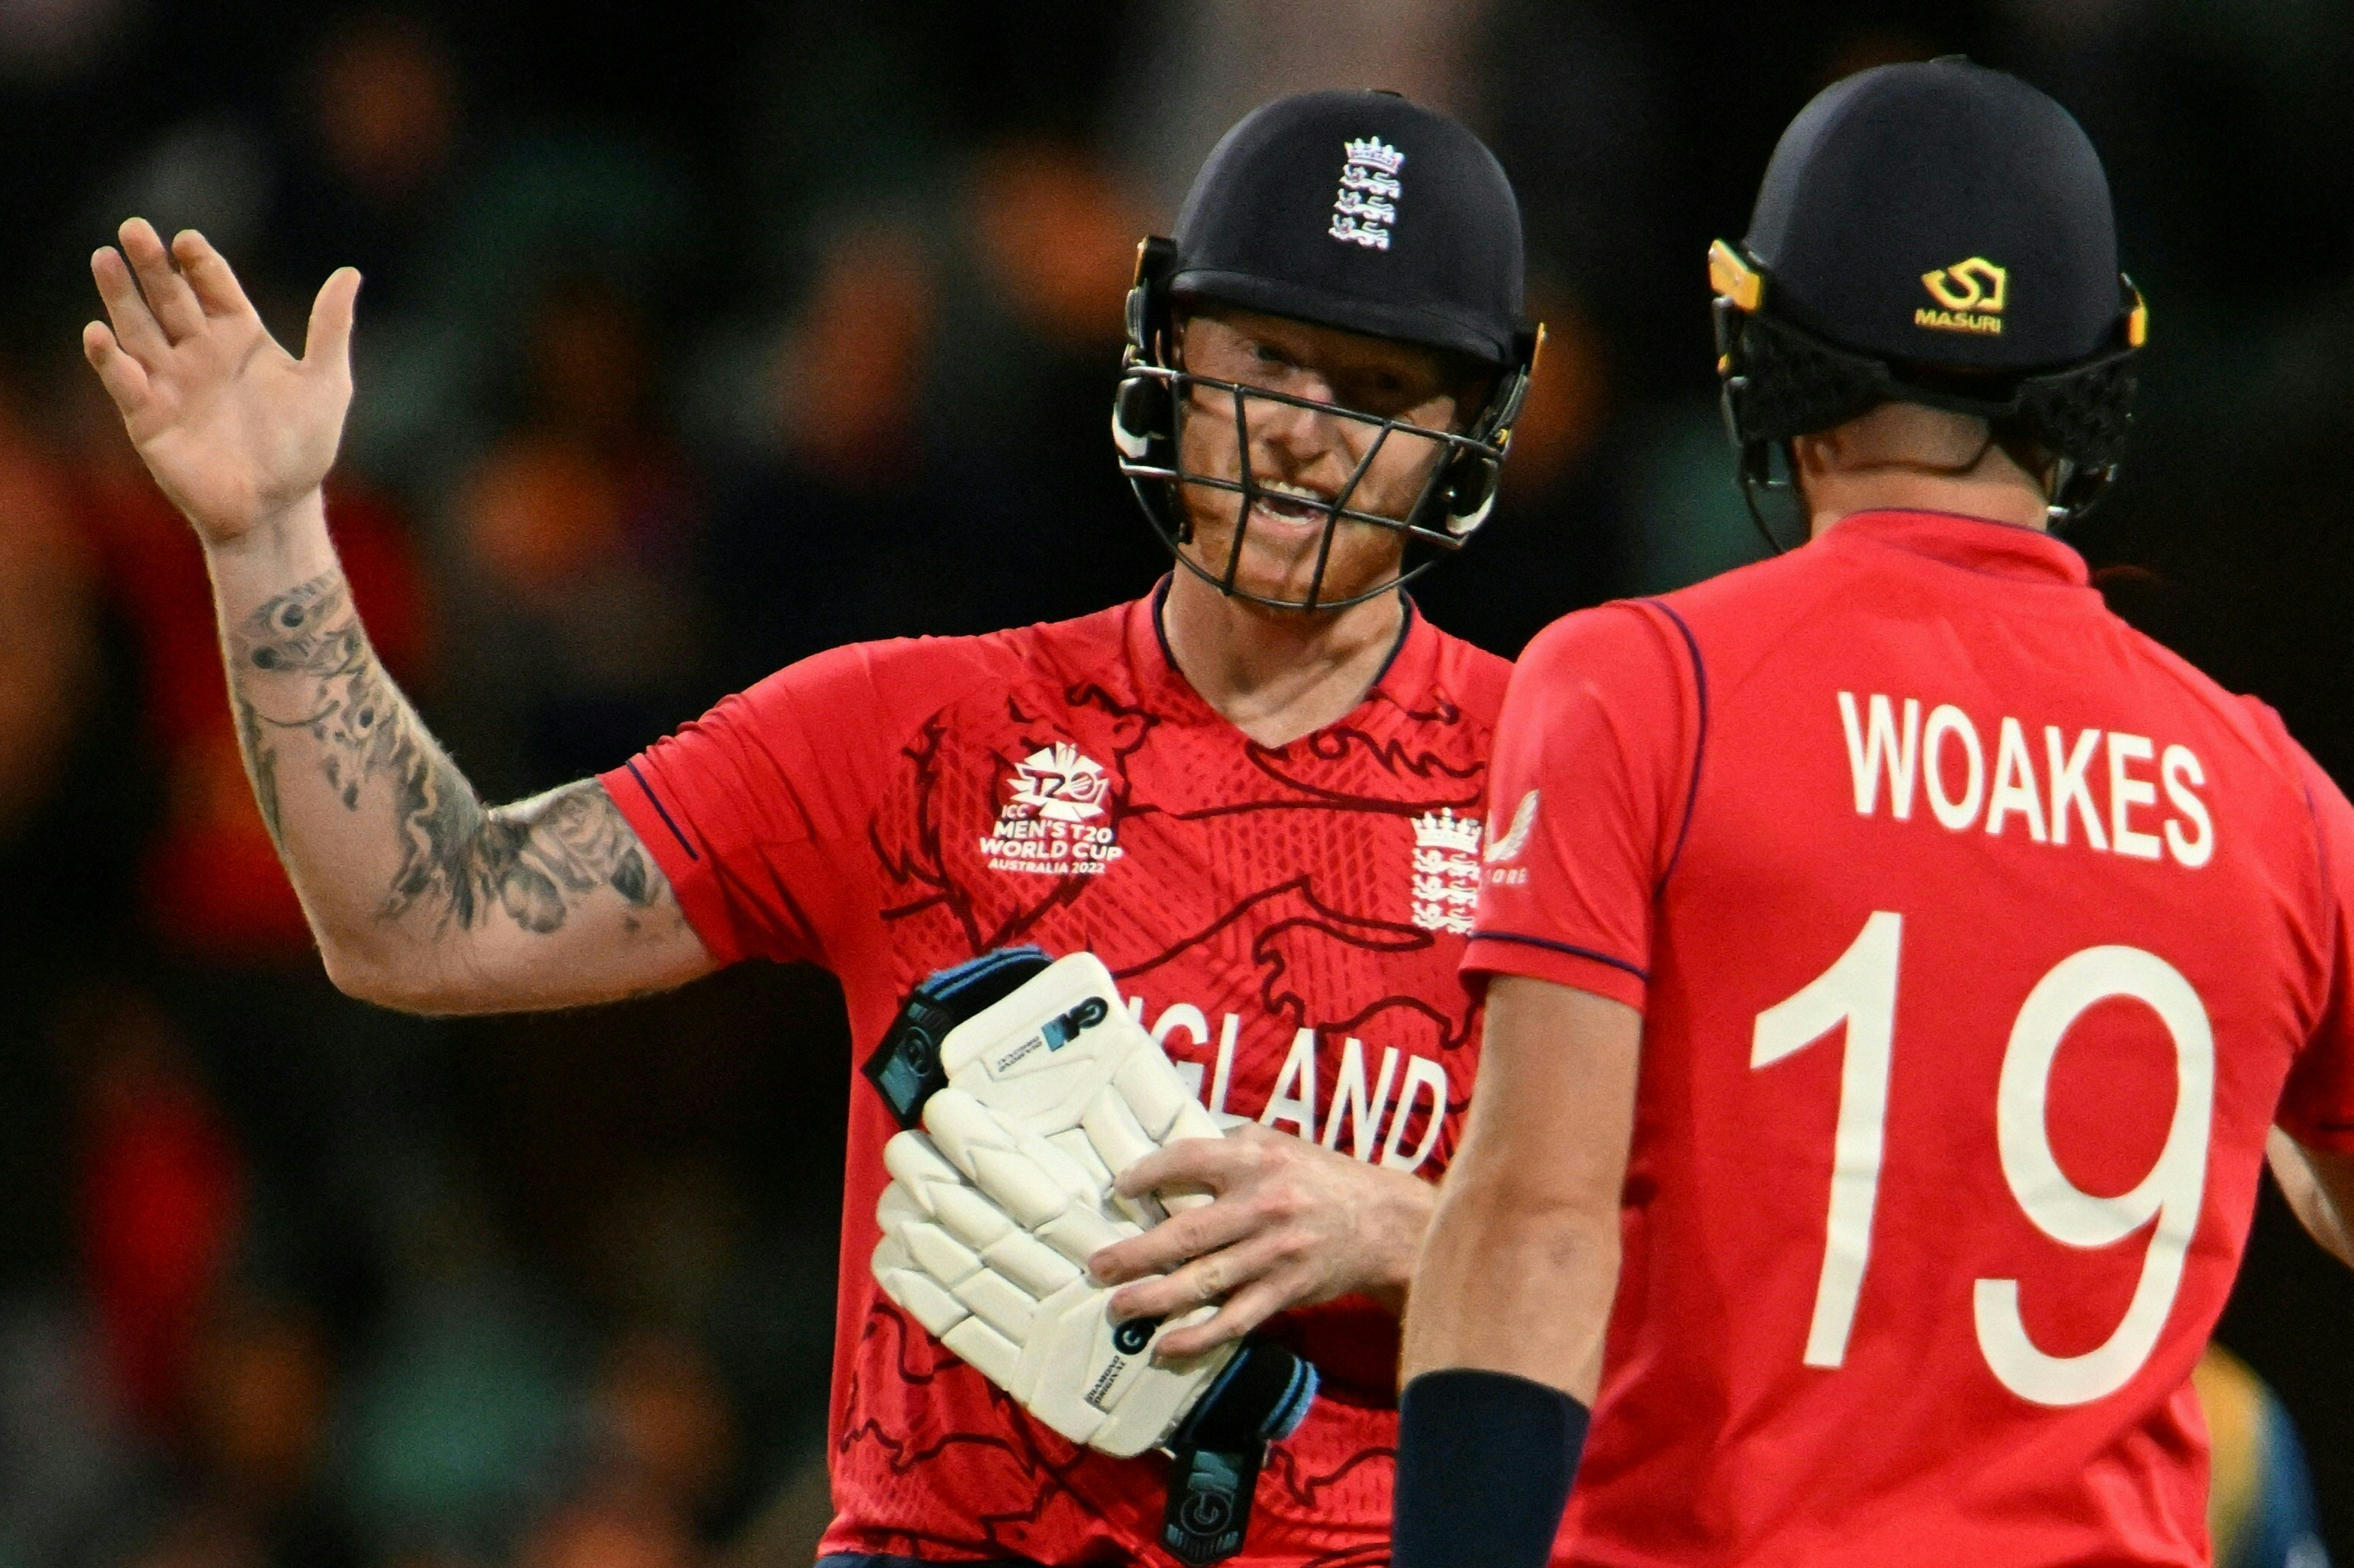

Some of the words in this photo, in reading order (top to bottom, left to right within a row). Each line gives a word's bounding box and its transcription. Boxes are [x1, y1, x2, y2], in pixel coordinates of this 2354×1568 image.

[1915, 308, 2001, 333] MASURI
[1838, 691, 2214, 868] WOAKES
[1001, 804, 1028, 818] ICC
[992, 820, 1066, 838] MEN'S
[1070, 824, 1112, 844] T20
[980, 837, 1068, 858] WORLD
[1072, 841, 1124, 861] CUP
[988, 858, 1069, 873] AUSTRALIA
[1071, 862, 1106, 874] 2022
[1128, 995, 1449, 1174] GLAND
[1750, 910, 2214, 1406] 19
